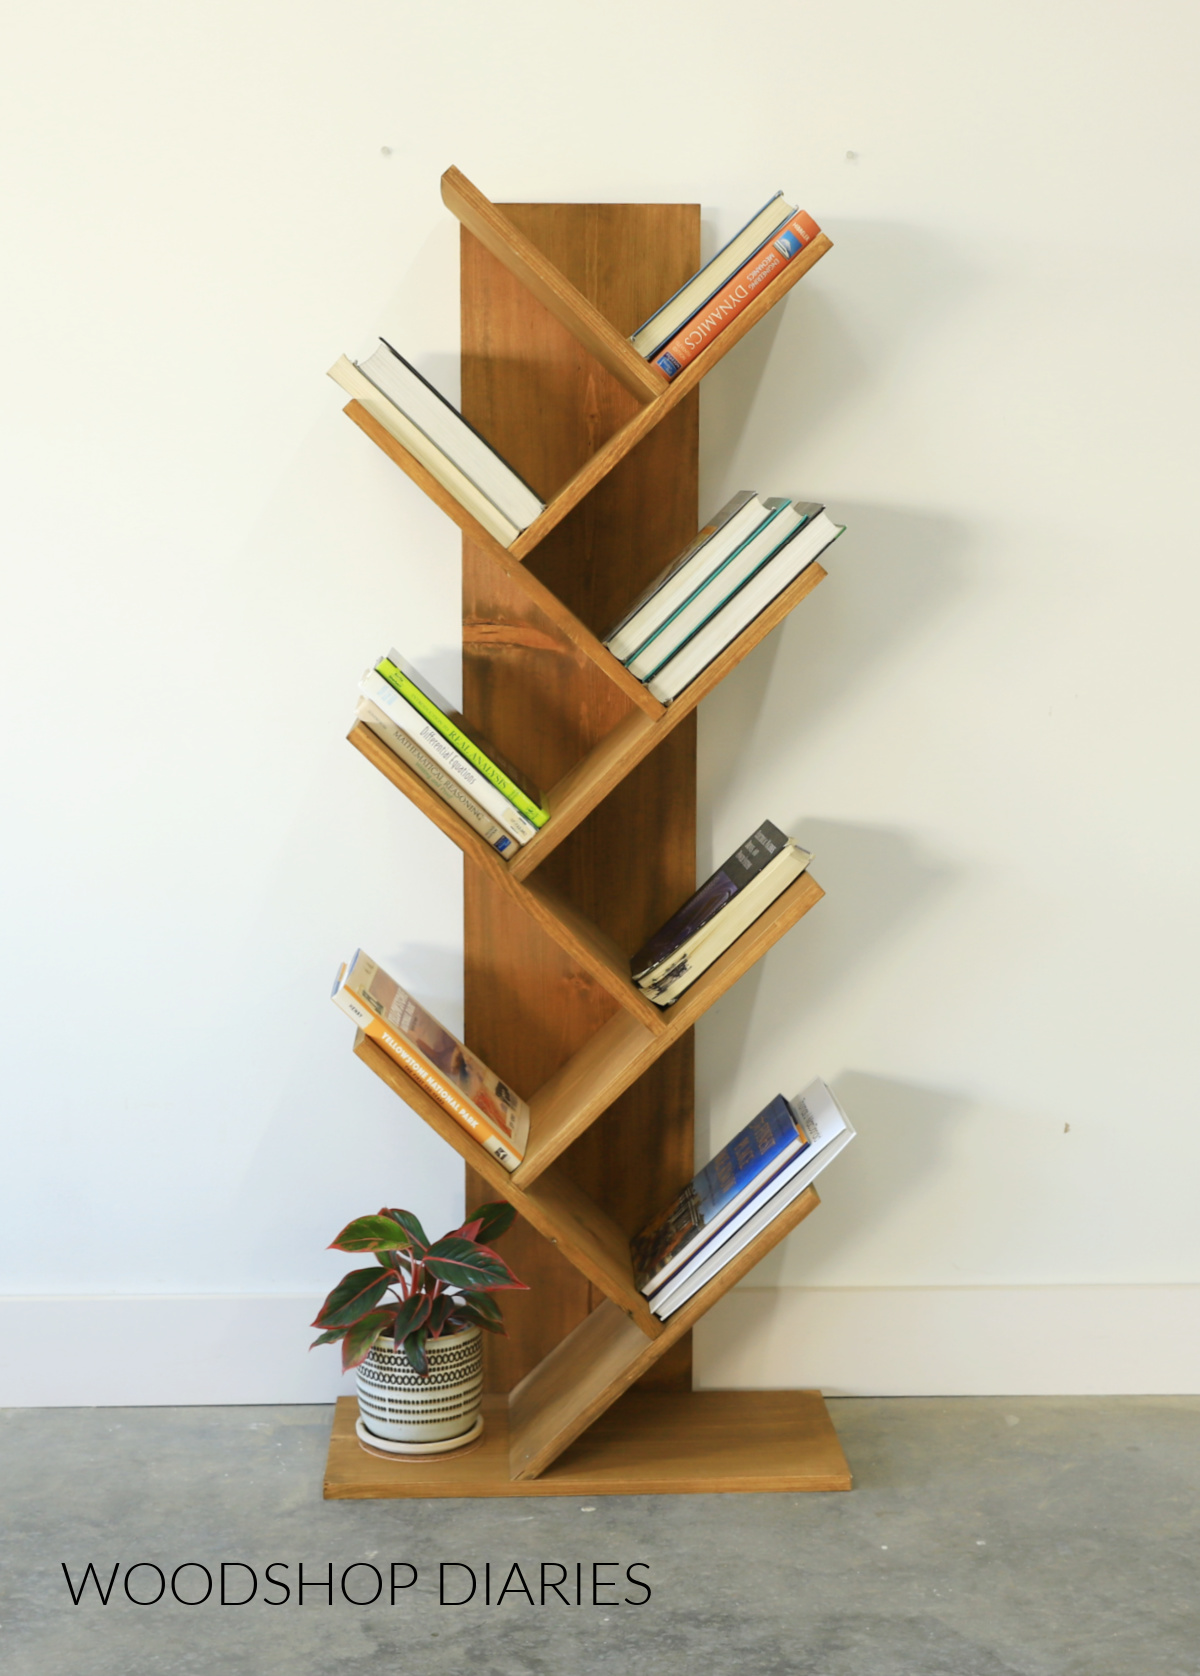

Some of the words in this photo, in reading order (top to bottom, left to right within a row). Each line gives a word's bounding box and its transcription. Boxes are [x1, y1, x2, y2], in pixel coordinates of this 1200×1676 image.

[745, 252, 775, 282] MECHANICS
[747, 257, 780, 290] ENGINEERING
[682, 283, 749, 350] DYNAMICS
[392, 730, 445, 782] MATHEMATICAL
[443, 779, 484, 821] REASONING
[418, 725, 454, 760] Differential
[446, 754, 478, 786] Equations
[447, 729, 473, 755] REAL
[466, 747, 509, 790] ANALYSIS
[379, 1031, 429, 1080] YELLOWSTONE
[424, 1075, 461, 1111] NATIONAL
[457, 1107, 479, 1129] PARK
